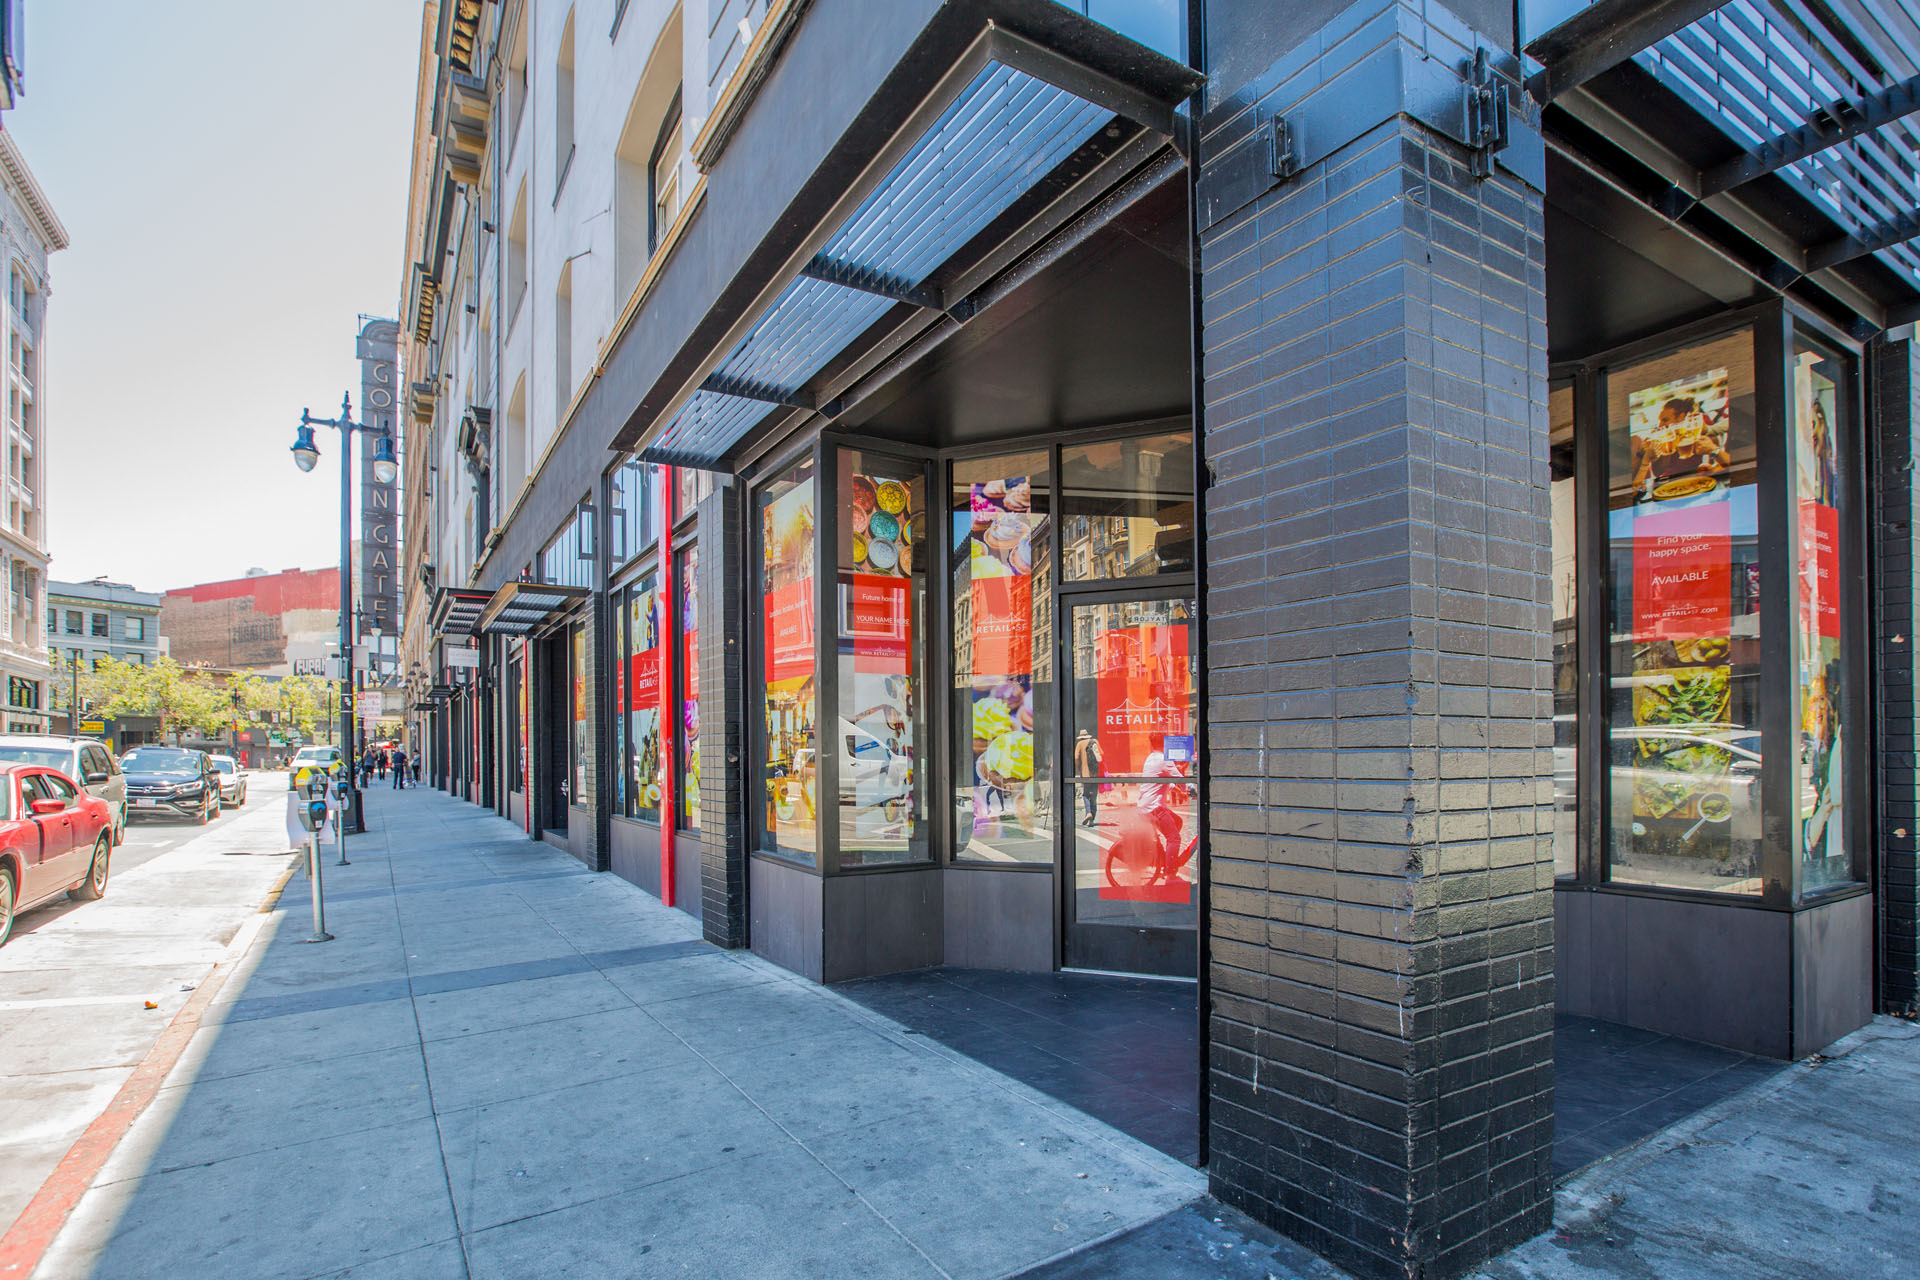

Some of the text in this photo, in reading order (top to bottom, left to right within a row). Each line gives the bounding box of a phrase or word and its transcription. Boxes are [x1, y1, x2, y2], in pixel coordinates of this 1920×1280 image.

[1657, 533, 1703, 545] Find your
[1649, 543, 1711, 558] happy space.
[373, 524, 388, 619] GATE
[1651, 570, 1709, 587] AVAILABLE
[862, 593, 880, 601] Future
[976, 624, 1010, 633] RETAIL
[640, 678, 653, 689] RETAIL
[1105, 714, 1157, 725] RETAIL
